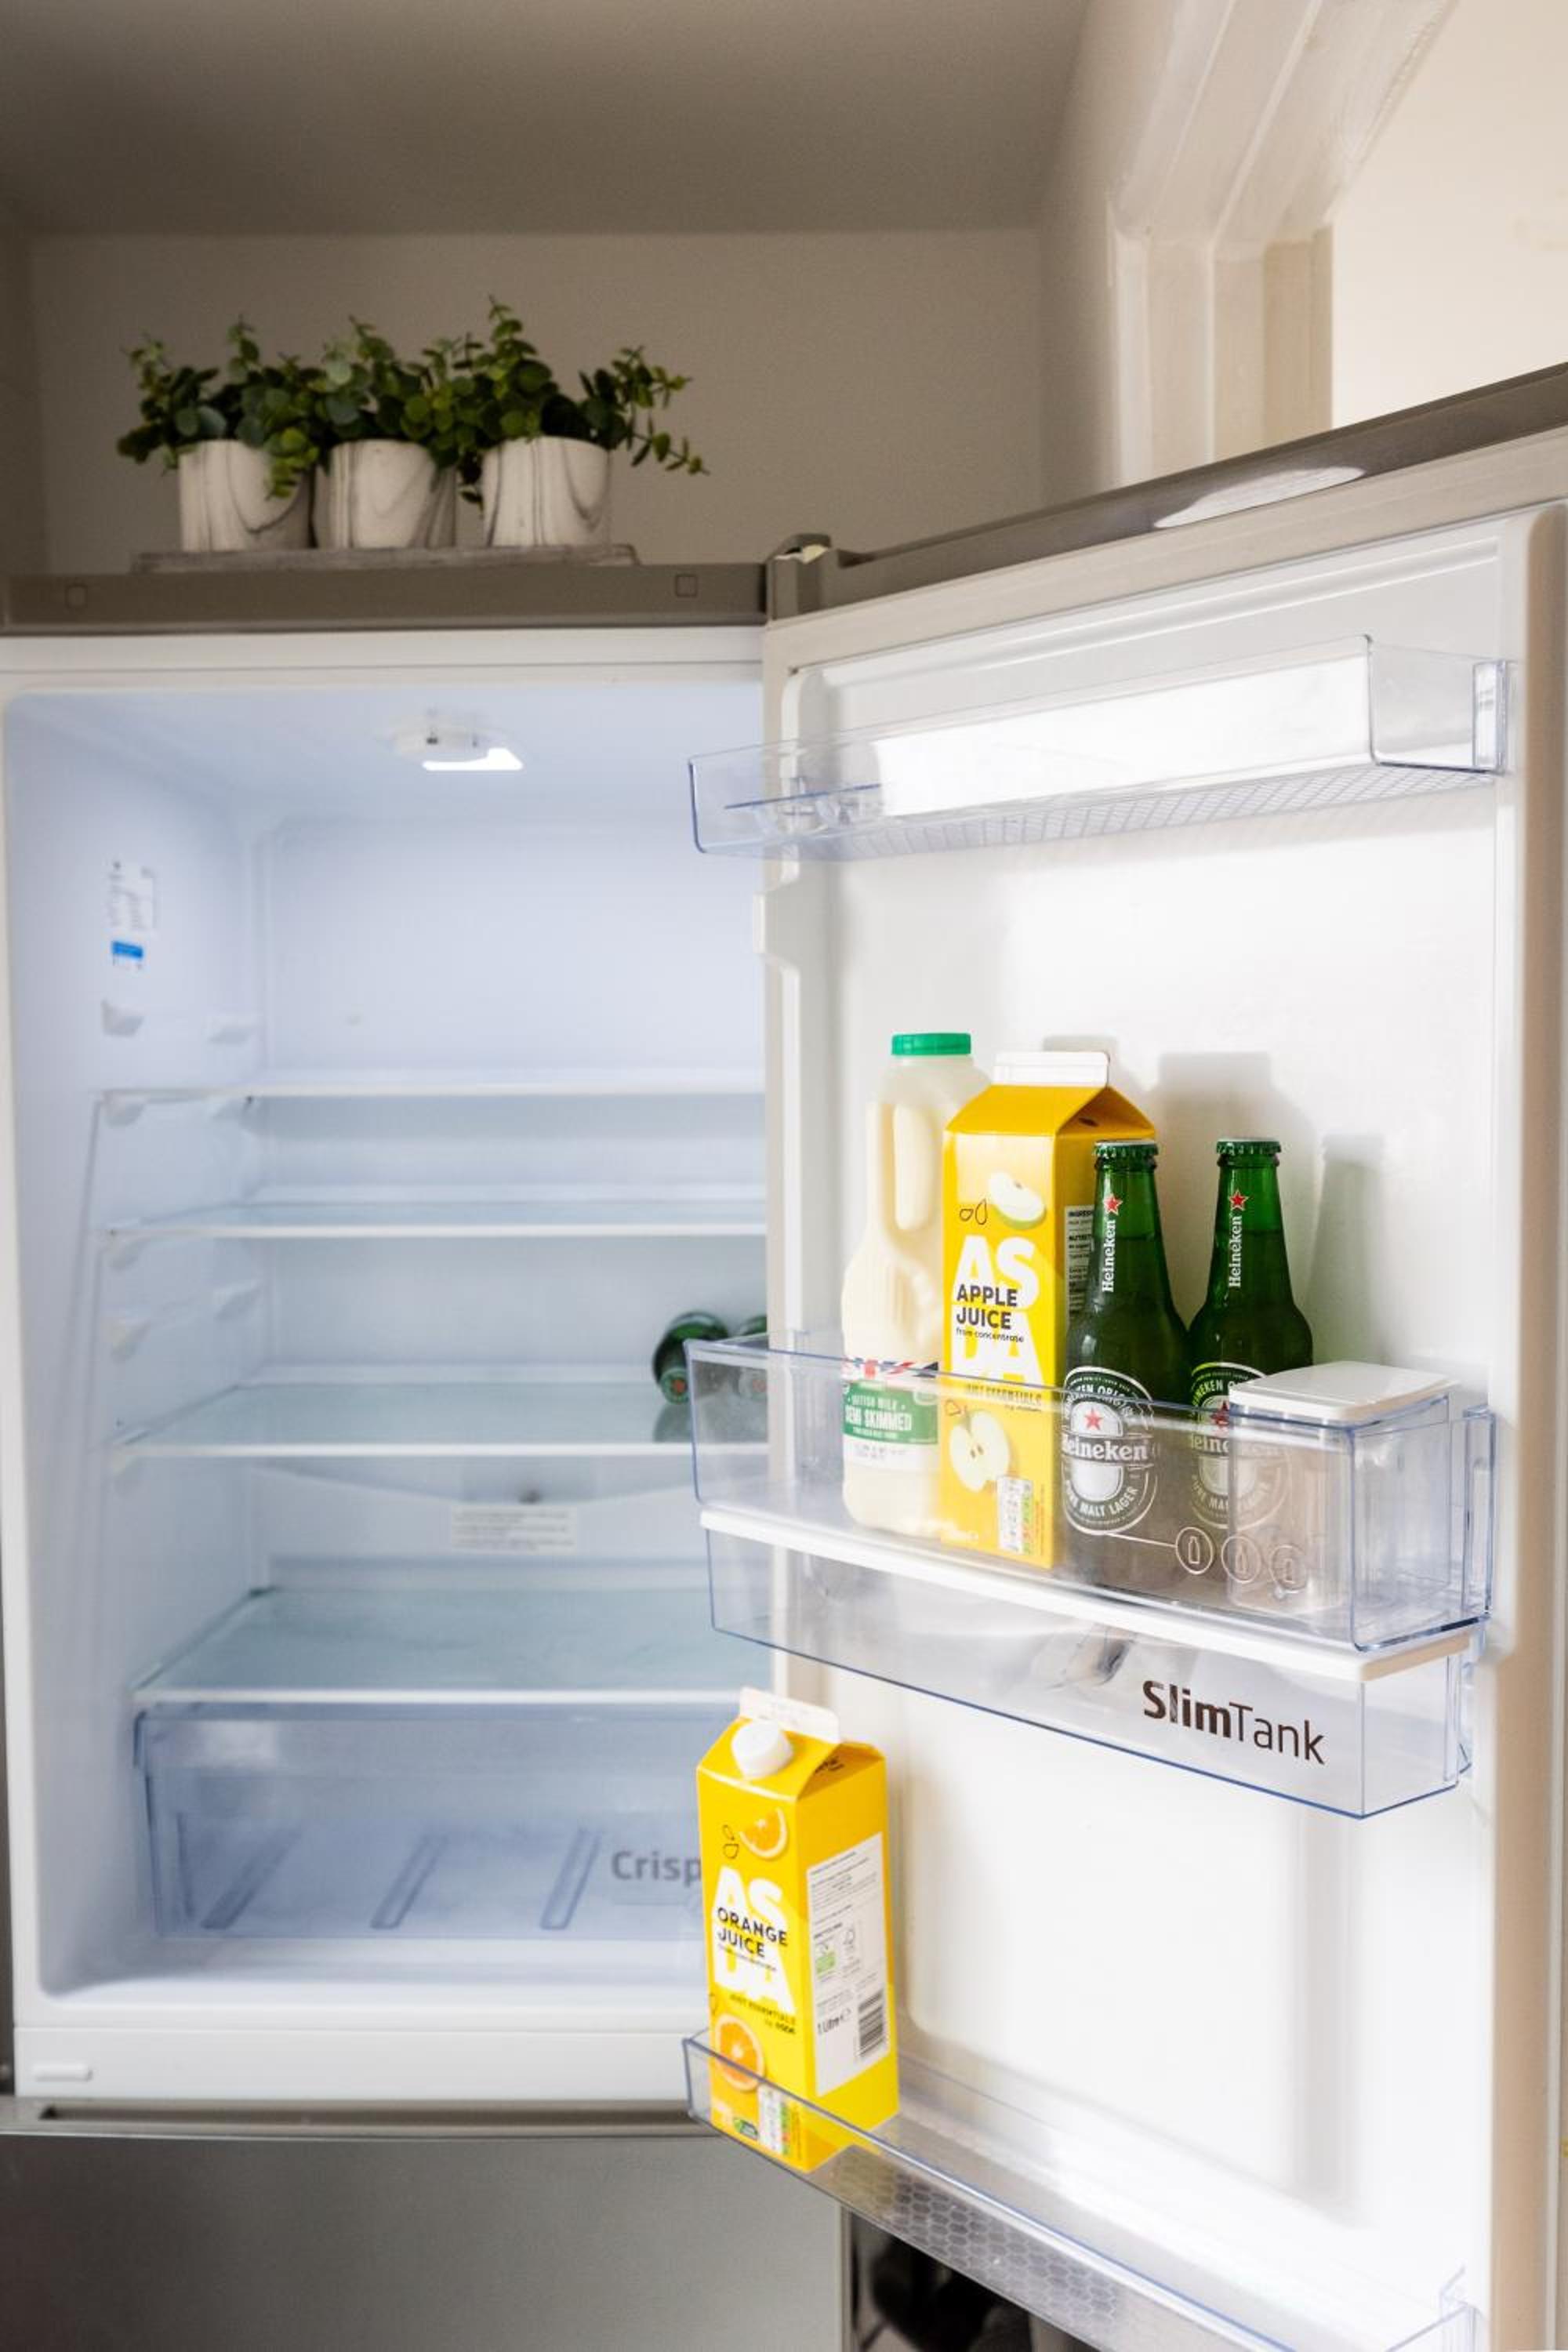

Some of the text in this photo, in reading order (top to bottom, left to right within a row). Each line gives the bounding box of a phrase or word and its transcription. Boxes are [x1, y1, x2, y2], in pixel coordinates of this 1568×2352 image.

[1102, 1219, 1116, 1293] Heineken
[1229, 1215, 1243, 1288] Heineken
[956, 1283, 1018, 1307] APPLE
[956, 1307, 1012, 1330] JUICE
[1080, 1501, 1105, 1518] MALT
[1109, 1486, 1138, 1515] LAGER
[1142, 1680, 1326, 1766] SlimTank
[717, 1906, 789, 1947] ORANGE
[717, 1927, 766, 1958] JUICE
